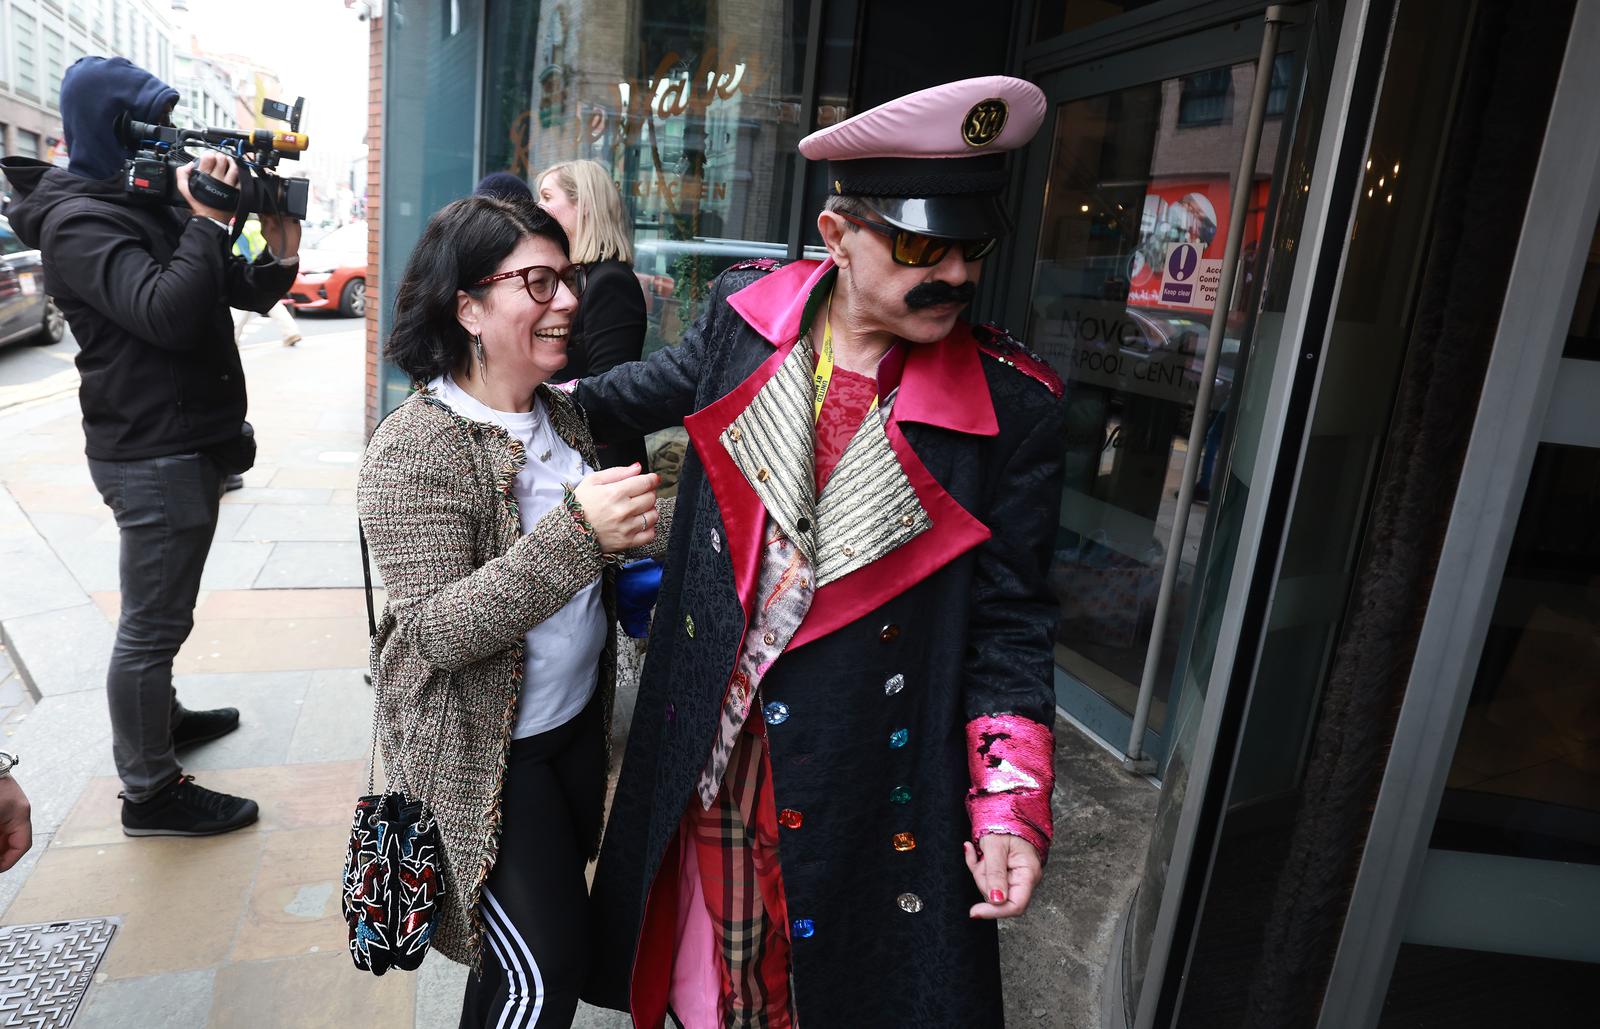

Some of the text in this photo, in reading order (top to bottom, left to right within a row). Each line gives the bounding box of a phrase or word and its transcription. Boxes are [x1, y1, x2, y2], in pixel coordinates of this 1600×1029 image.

[205, 184, 229, 199] SONY
[632, 180, 727, 201] KITCHEN
[1199, 275, 1220, 283] Contr
[1163, 287, 1177, 297] Keep
[1177, 288, 1191, 298] clear
[1204, 294, 1217, 302] Do
